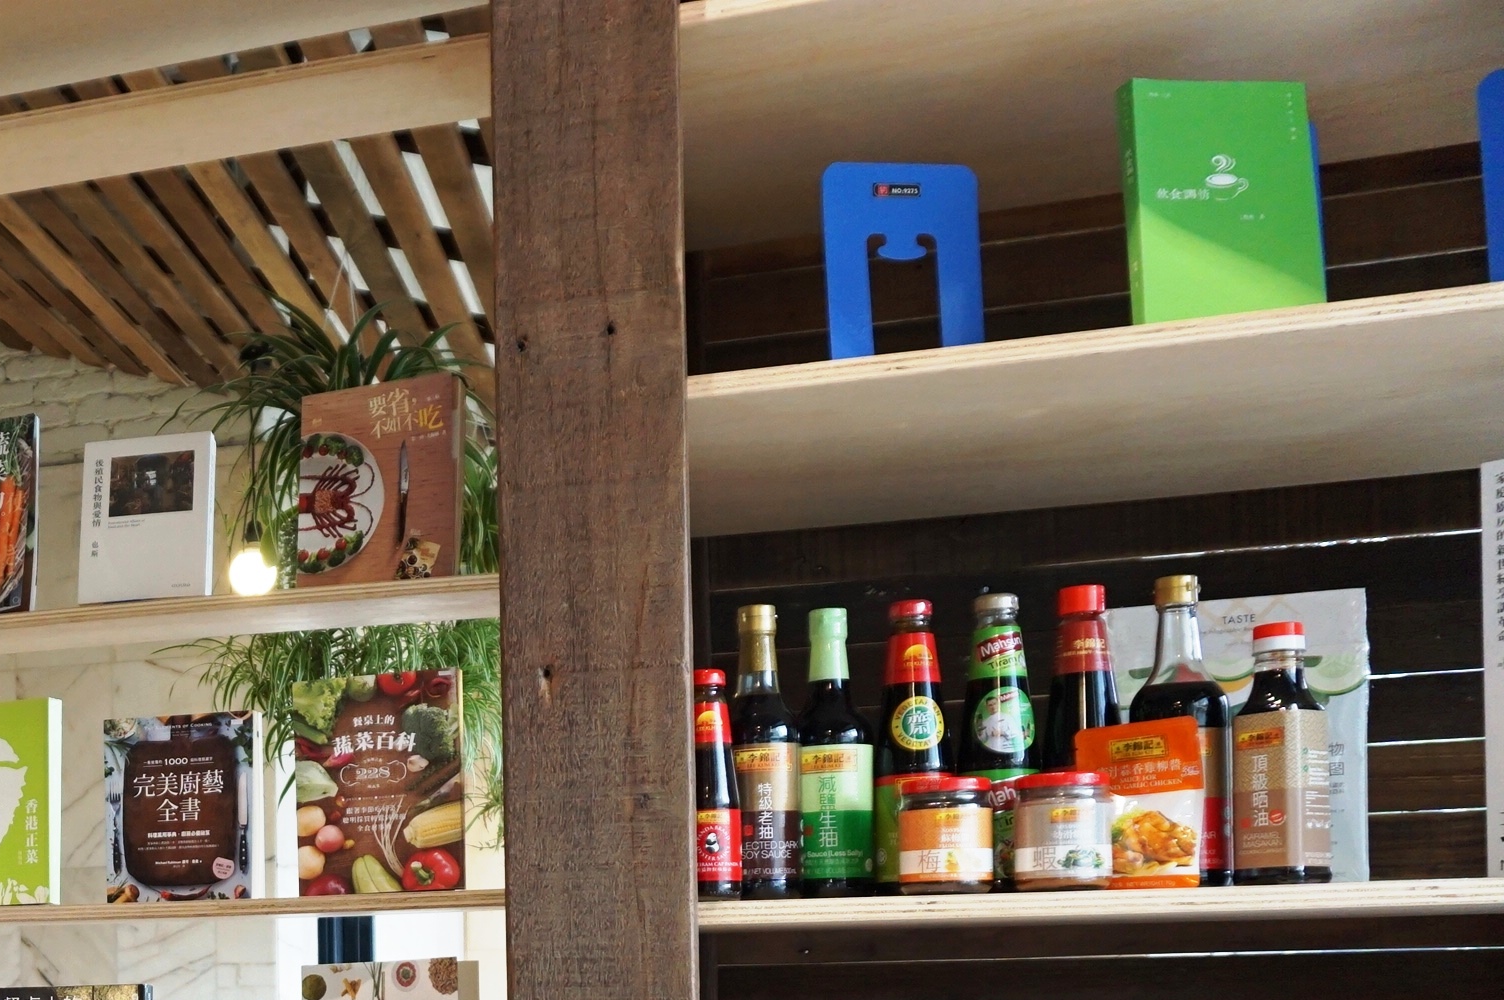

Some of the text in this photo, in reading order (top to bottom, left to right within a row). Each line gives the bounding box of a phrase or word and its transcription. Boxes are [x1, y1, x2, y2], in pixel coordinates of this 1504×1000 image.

[370, 405, 444, 440] 不如不吃
[92, 458, 104, 528] 後殖民食物與愛情
[1222, 614, 1256, 624] TASTE
[987, 657, 1017, 669] Tiram
[353, 715, 395, 727] 餐桌上的
[1248, 733, 1271, 741] 李錦記
[332, 731, 416, 757] 蔬菜百科
[1122, 740, 1153, 752] 李錦記
[164, 757, 189, 766] 1000
[748, 753, 780, 763] 李錦記
[813, 753, 844, 763] 李錦記
[356, 766, 391, 779] 228
[133, 769, 224, 798] 完美廚藝
[1123, 778, 1183, 790] GARLIC CHICKEN
[156, 797, 201, 823] 全書
[758, 782, 773, 839] 特級老抽
[818, 775, 839, 848] 減鹽生抽
[24, 799, 38, 864] 香港正菜
[778, 840, 798, 849] DARK
[1245, 840, 1282, 848] MASAKAN
[741, 850, 792, 859] SOY SAUCE
[1032, 846, 1056, 871] 蝦
[918, 850, 941, 874] 梅
